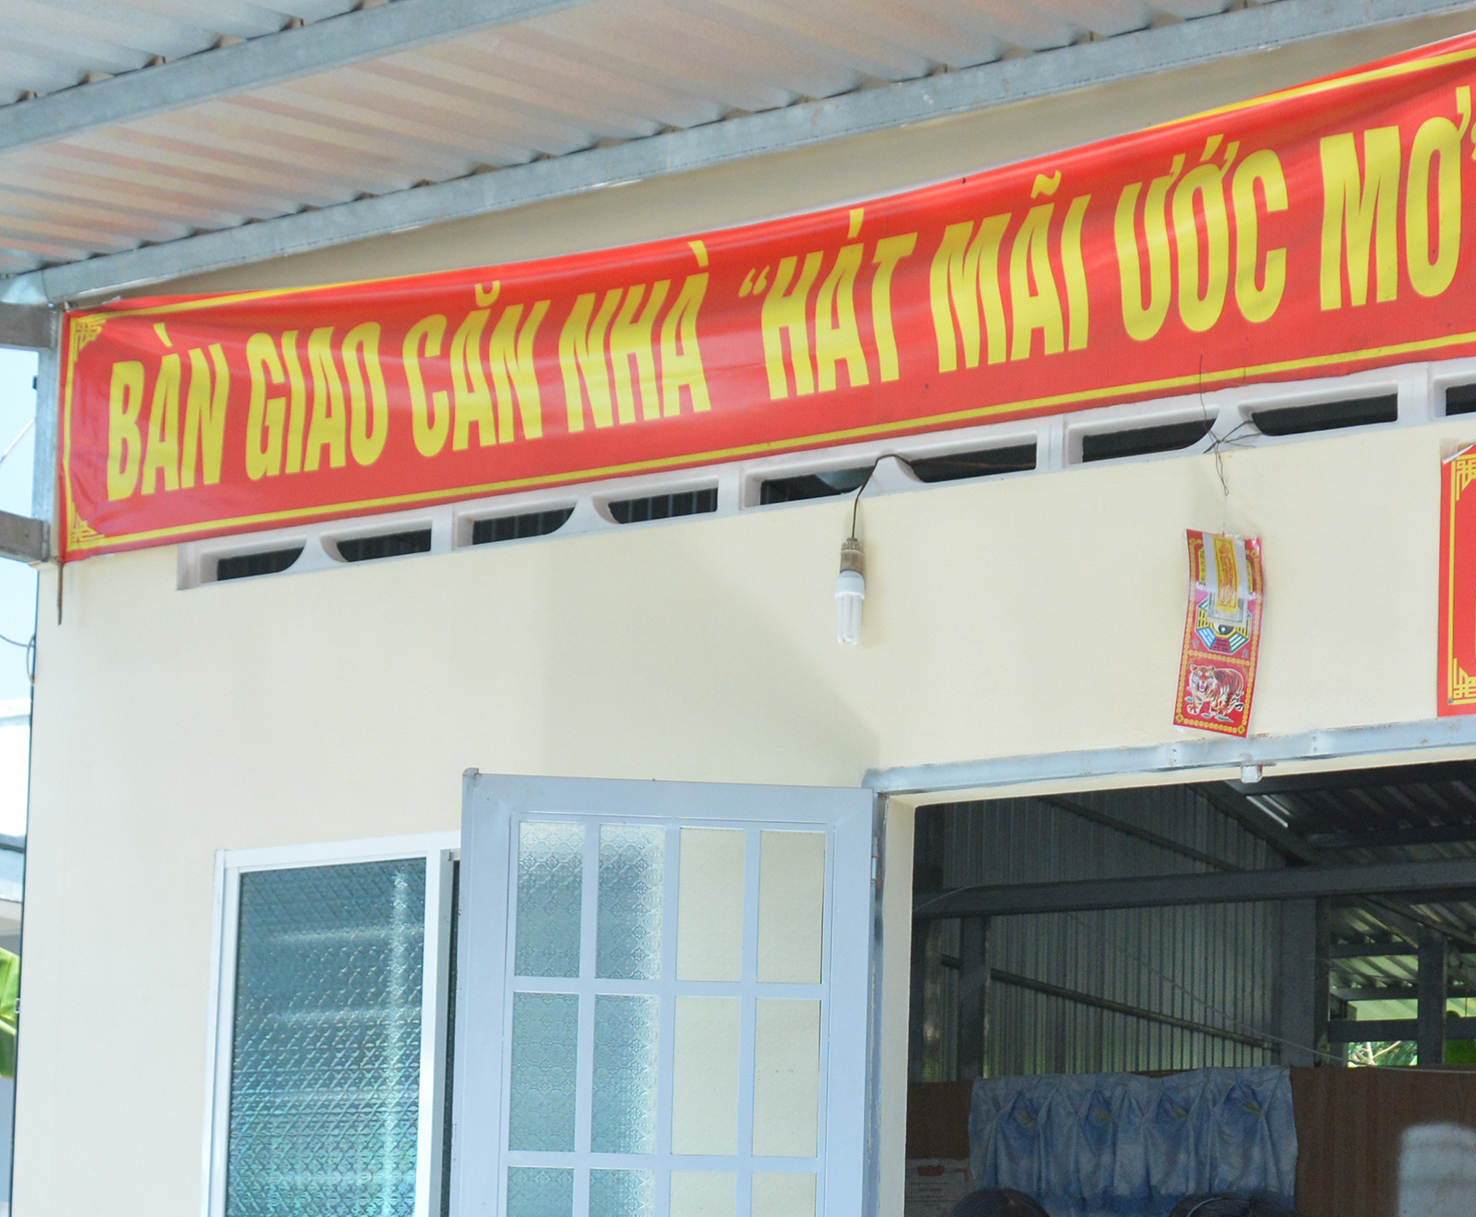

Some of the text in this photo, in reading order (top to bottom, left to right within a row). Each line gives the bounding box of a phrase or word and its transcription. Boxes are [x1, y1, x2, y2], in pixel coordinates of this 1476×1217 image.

[107, 322, 231, 501] BÀN
[246, 322, 389, 481] GIAO
[402, 280, 551, 459] CĂN
[558, 240, 713, 434] NHÀ
[929, 170, 1091, 373] MÃI
[1114, 134, 1288, 341] ƯỚC
